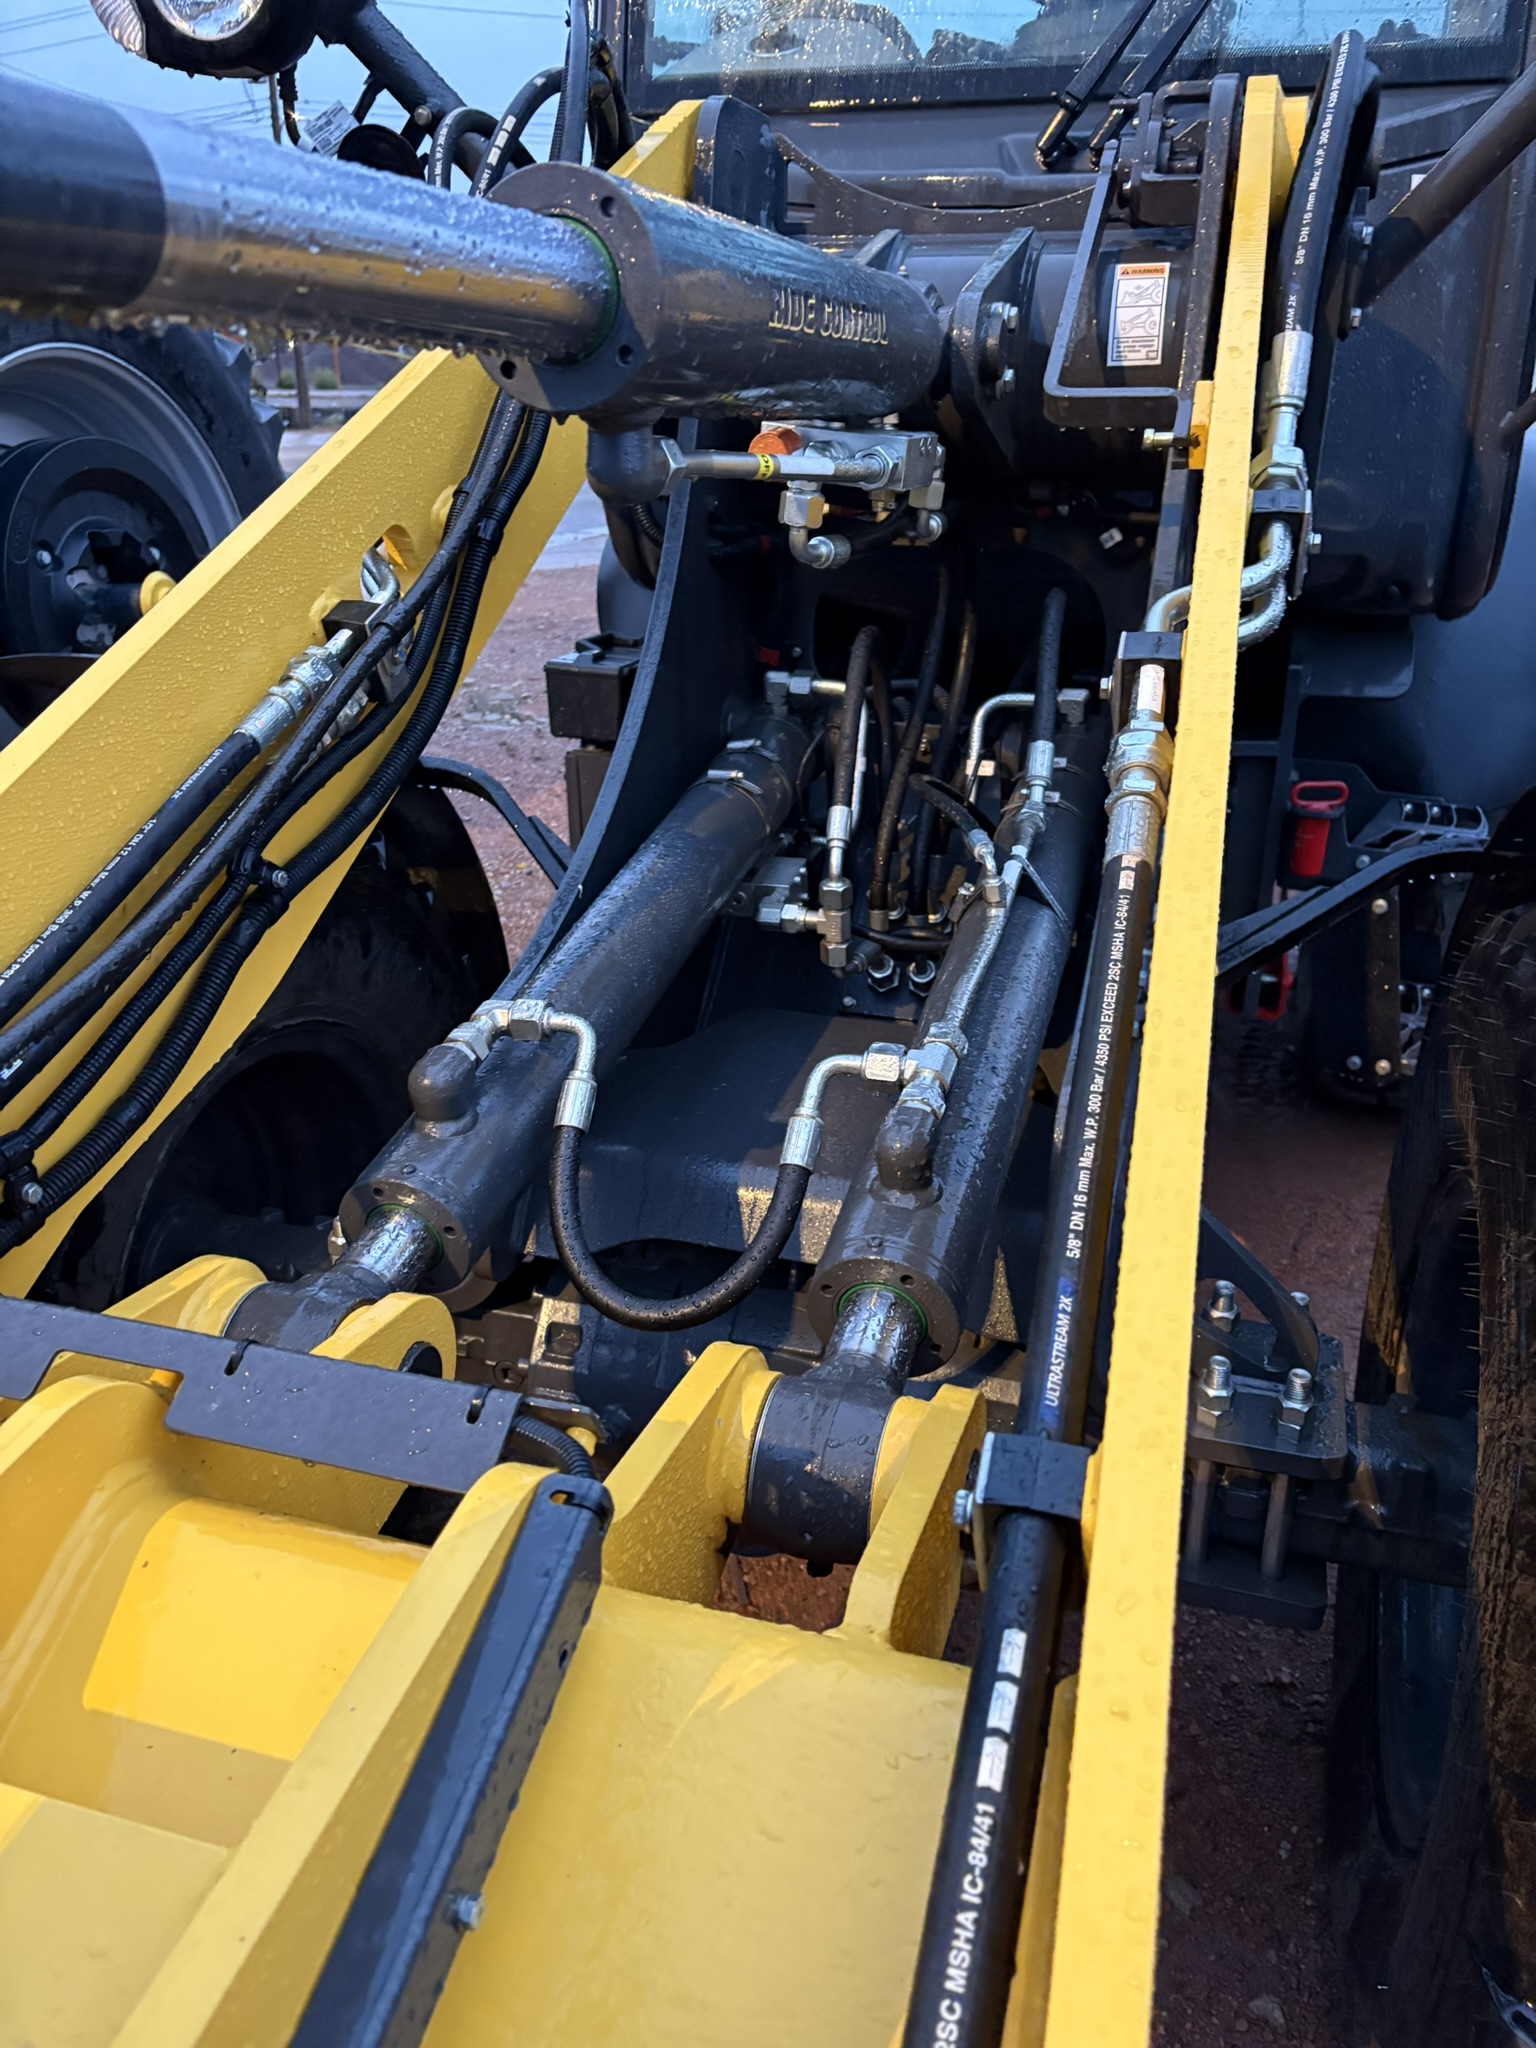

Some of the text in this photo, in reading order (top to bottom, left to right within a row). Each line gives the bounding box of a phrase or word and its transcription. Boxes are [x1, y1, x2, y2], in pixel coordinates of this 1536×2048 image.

[1331, 77, 1342, 90] PSI
[1322, 113, 1333, 128] Bar
[1318, 128, 1331, 145] 300
[1308, 168, 1322, 190] Max.
[1306, 191, 1316, 211] mm
[1298, 226, 1310, 242] DN
[1131, 267, 1165, 275] WARNING
[1288, 294, 1297, 307] 2K
[768, 287, 889, 345] RIDE CONTROL
[128, 833, 144, 846] DN
[119, 846, 132, 856] 12
[1114, 894, 1130, 930] IC-84/41
[40, 924, 60, 939] Bar
[1110, 931, 1126, 960] MSHA
[0, 963, 21, 978] PSI
[1108, 961, 1121, 982] 2SC
[1100, 982, 1118, 1023] EXCEED
[1098, 1024, 1113, 1041] PSI
[1094, 1043, 1110, 1067] 4350
[1090, 1073, 1105, 1092] Bar
[1087, 1093, 1102, 1113] 300
[1083, 1115, 1099, 1140] W.P.
[1078, 1142, 1096, 1169] Max.
[1078, 1169, 1091, 1192] mm
[1072, 1193, 1088, 1208] 16
[1069, 1211, 1085, 1231] DN
[1066, 1232, 1082, 1259] 5/8"
[1044, 1294, 1073, 1407] ULTRASTREAM 2K
[960, 1802, 996, 1905] IC-84/41
[944, 1910, 979, 1994] MSHA
